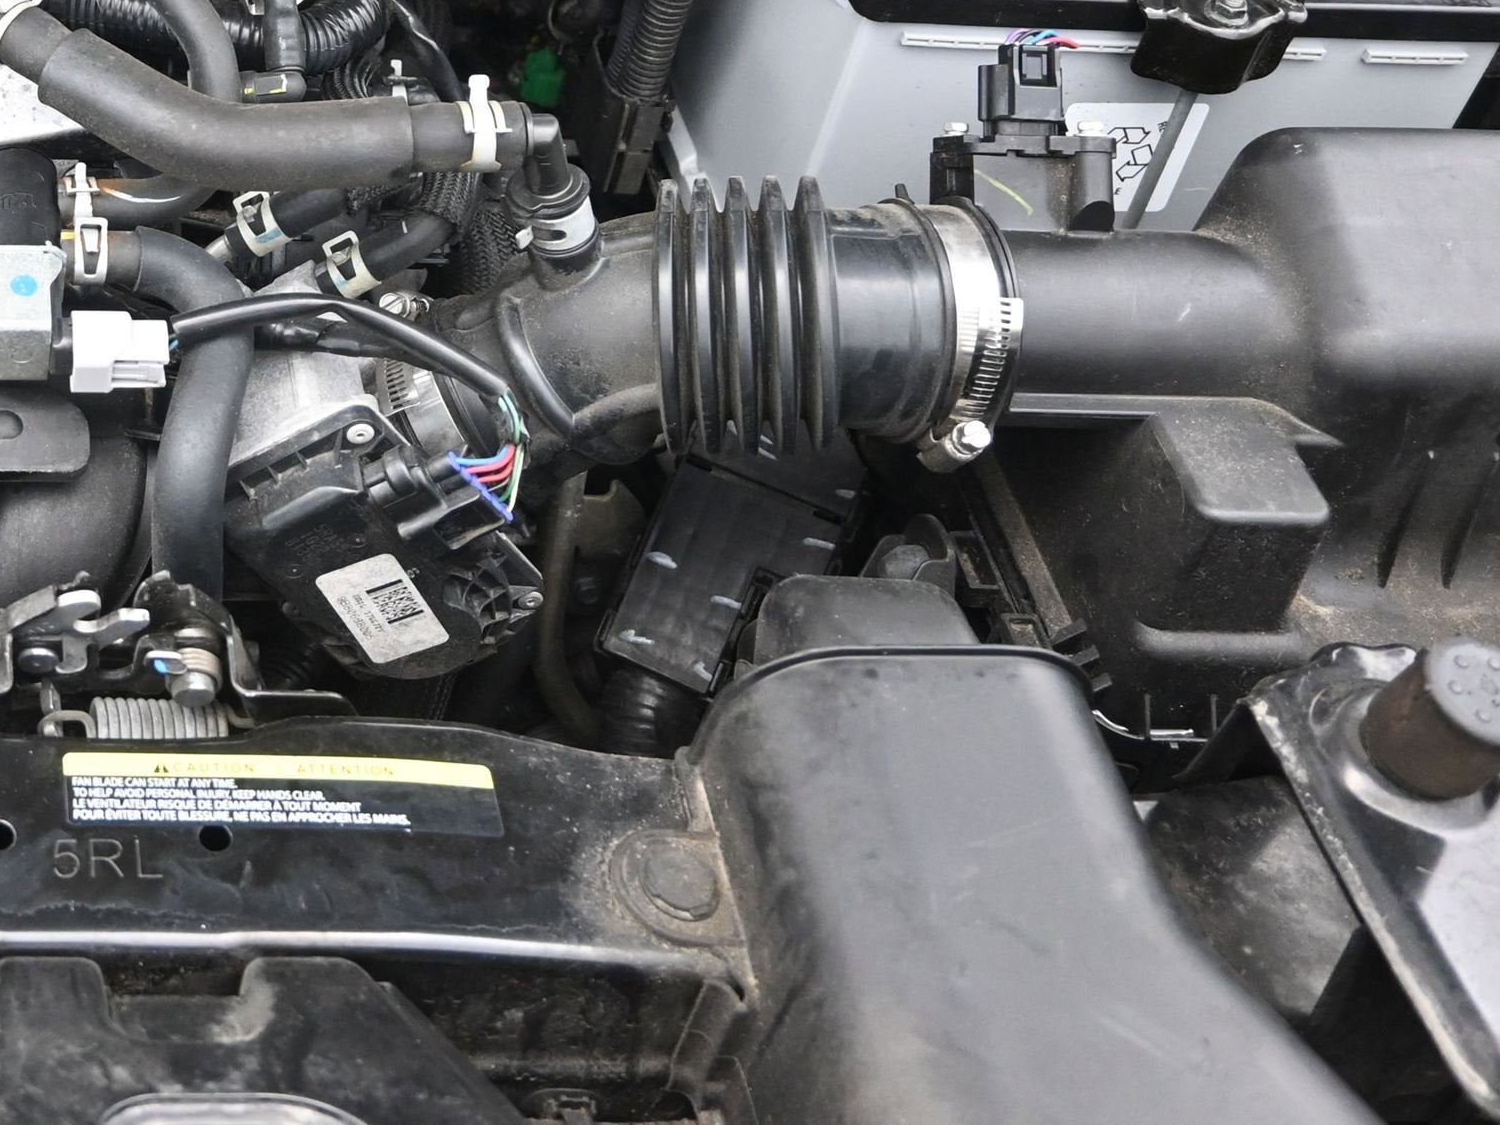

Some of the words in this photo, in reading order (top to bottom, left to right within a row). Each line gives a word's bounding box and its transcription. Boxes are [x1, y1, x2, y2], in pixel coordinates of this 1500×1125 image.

[173, 762, 256, 773] CAUTION
[297, 763, 396, 777] ATTENTION
[71, 776, 91, 787] FAN
[91, 777, 124, 787] BLADE
[126, 777, 146, 787] CAN
[148, 777, 176, 788] START
[178, 777, 190, 788] AT
[191, 778, 212, 788] ANY
[73, 787, 89, 798] TO
[89, 787, 113, 798] HELP
[114, 787, 145, 798] AVOID
[146, 788, 195, 799] PERSONAL
[232, 789, 256, 800] KEEP
[257, 789, 292, 800] HANDS
[73, 799, 86, 809] LE
[88, 799, 156, 810] VENTILATEUR
[157, 799, 197, 811] RISQUE
[198, 800, 214, 810] DE
[283, 801, 311, 812] TOUT
[312, 801, 361, 812] MOMENT
[73, 810, 104, 820] POUR
[143, 810, 177, 821] TOUTE
[234, 812, 248, 822] NE
[250, 812, 271, 823] PAS
[272, 812, 287, 823] EN
[288, 812, 352, 824] APPROCHER
[354, 813, 372, 824] LES
[51, 837, 164, 880] 5RL
